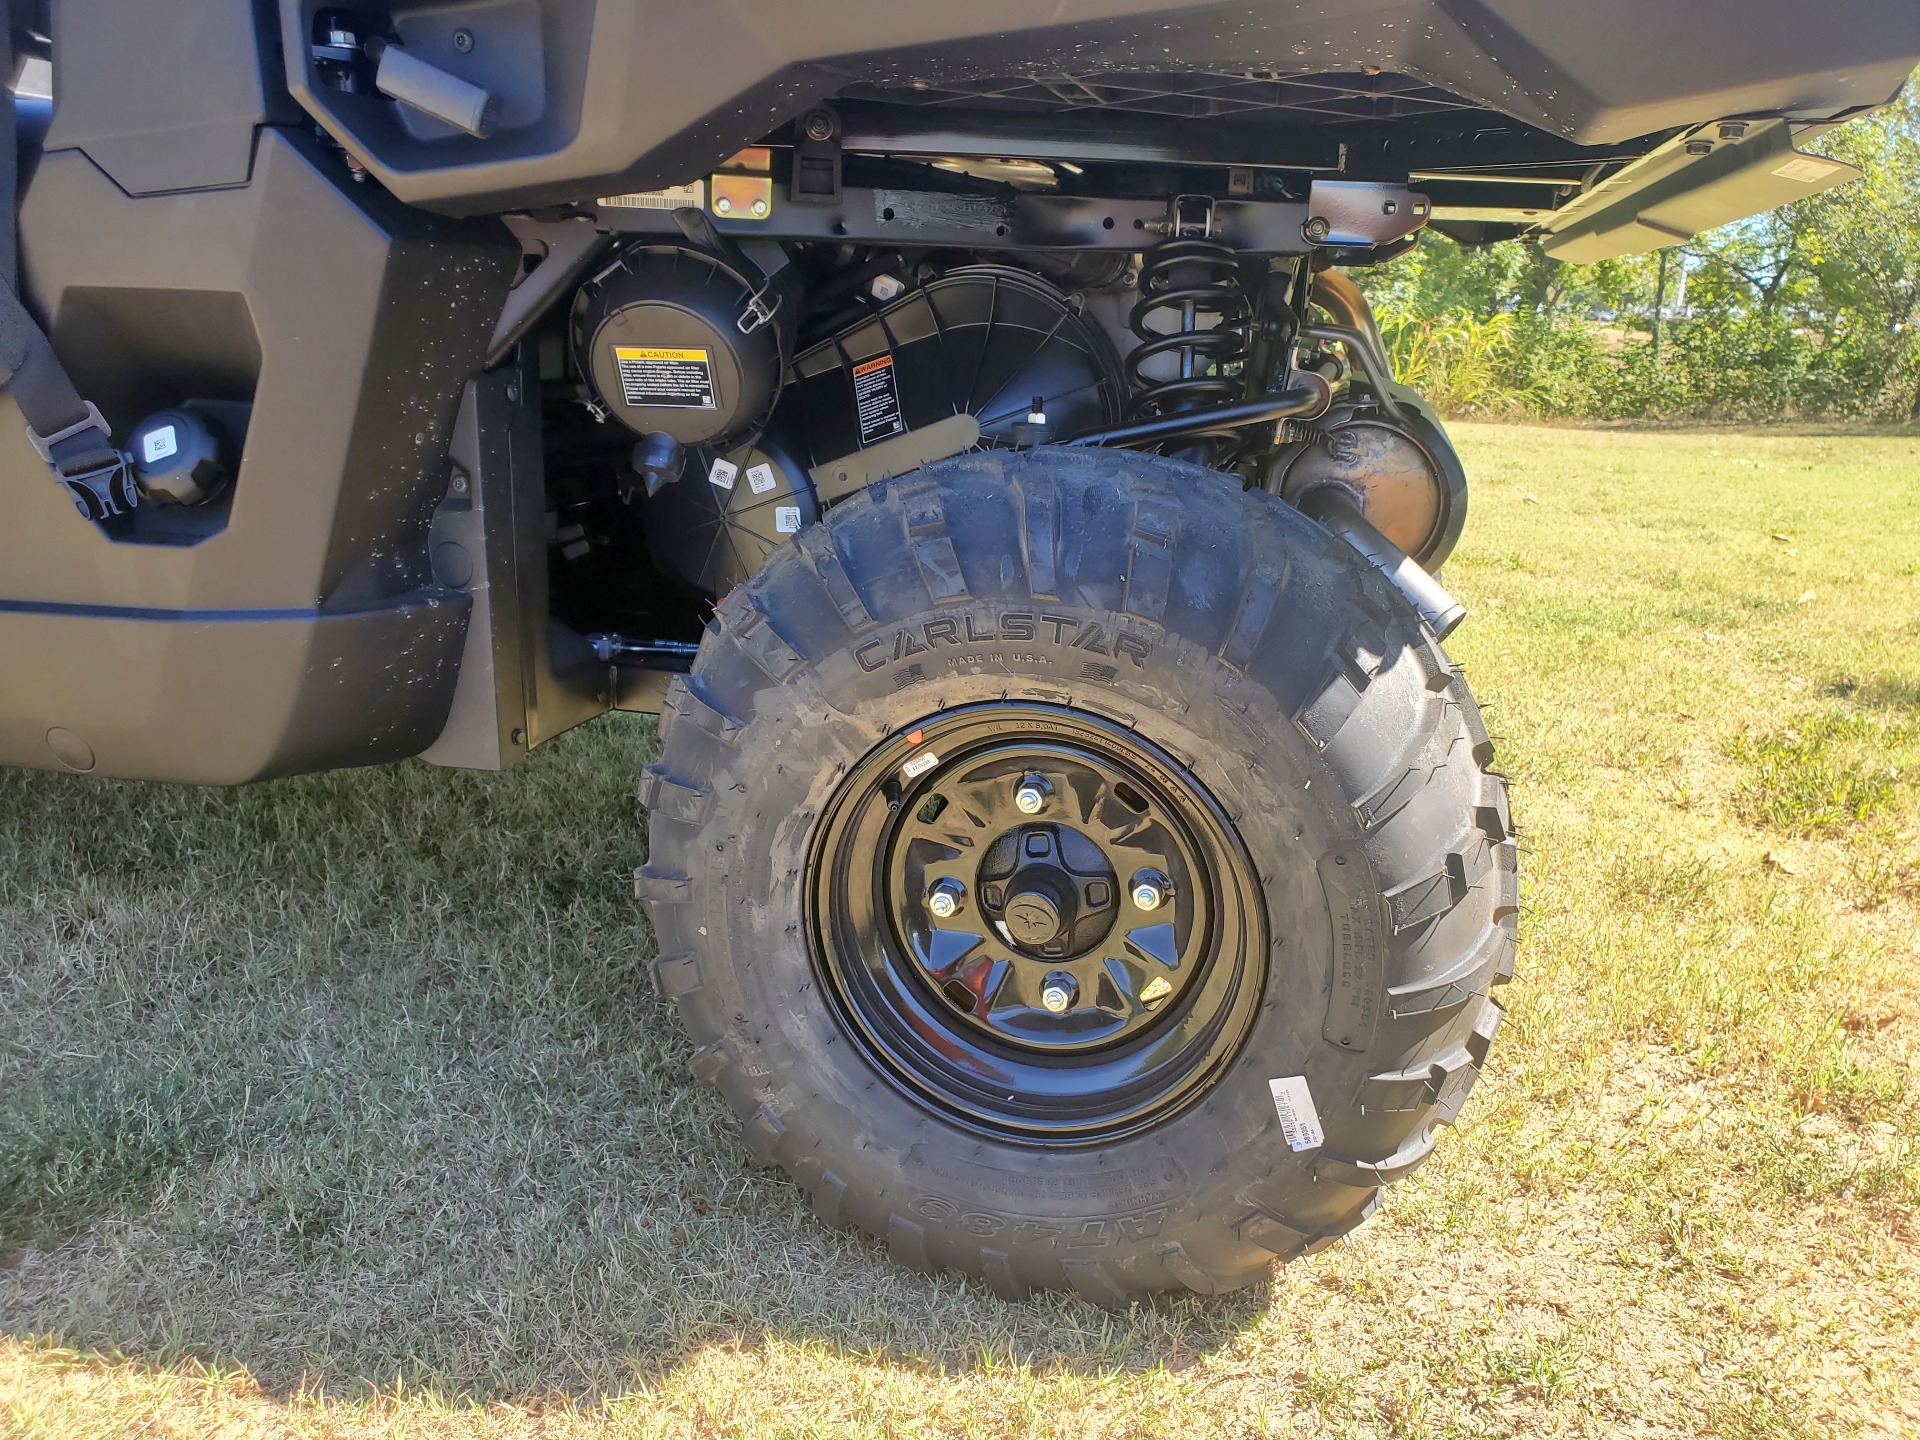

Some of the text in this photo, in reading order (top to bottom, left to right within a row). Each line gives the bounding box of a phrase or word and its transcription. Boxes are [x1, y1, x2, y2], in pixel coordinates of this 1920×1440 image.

[647, 351, 684, 359] CAUTION
[861, 357, 891, 372] WARNING
[853, 612, 1154, 674] CARLSTAR
[947, 653, 1053, 667] MADE IN U.S.A.
